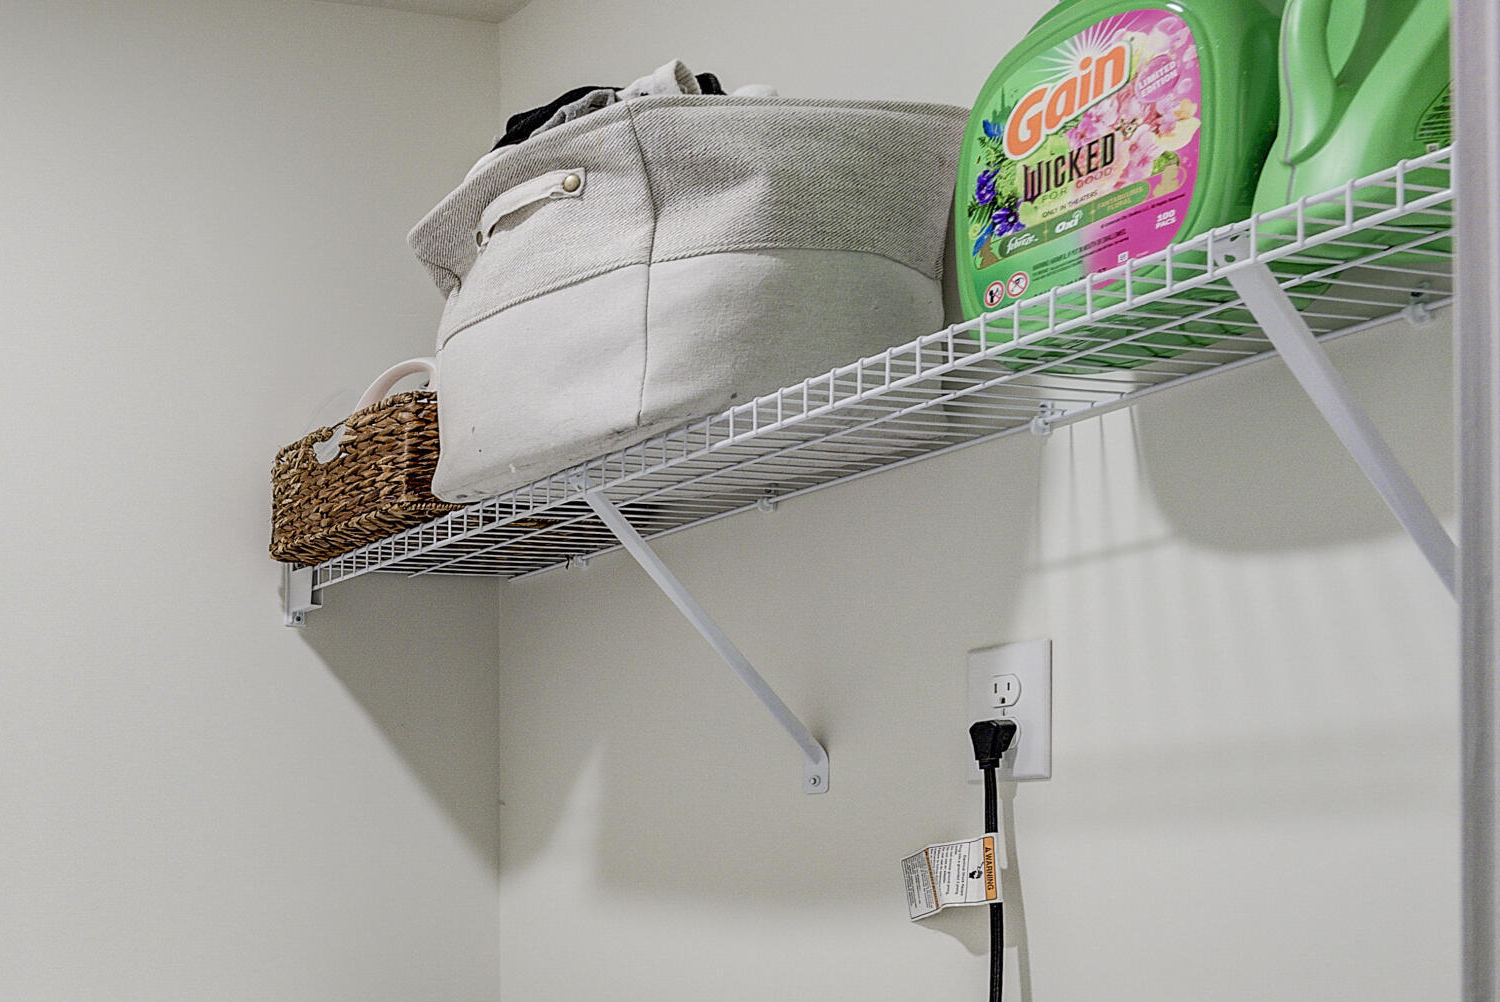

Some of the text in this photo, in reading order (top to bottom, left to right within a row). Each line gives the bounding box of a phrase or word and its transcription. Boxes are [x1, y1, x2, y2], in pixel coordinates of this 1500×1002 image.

[1139, 61, 1177, 89] LIMITED
[1140, 70, 1178, 98] EDITION
[1006, 45, 1127, 157] Gain
[1022, 132, 1115, 204] WICKED
[1042, 167, 1113, 203] FOR GOOD
[1042, 207, 1058, 218] ONLY
[1155, 216, 1176, 229] PACS
[1156, 209, 1176, 222] 100
[985, 854, 995, 891] WARNING
